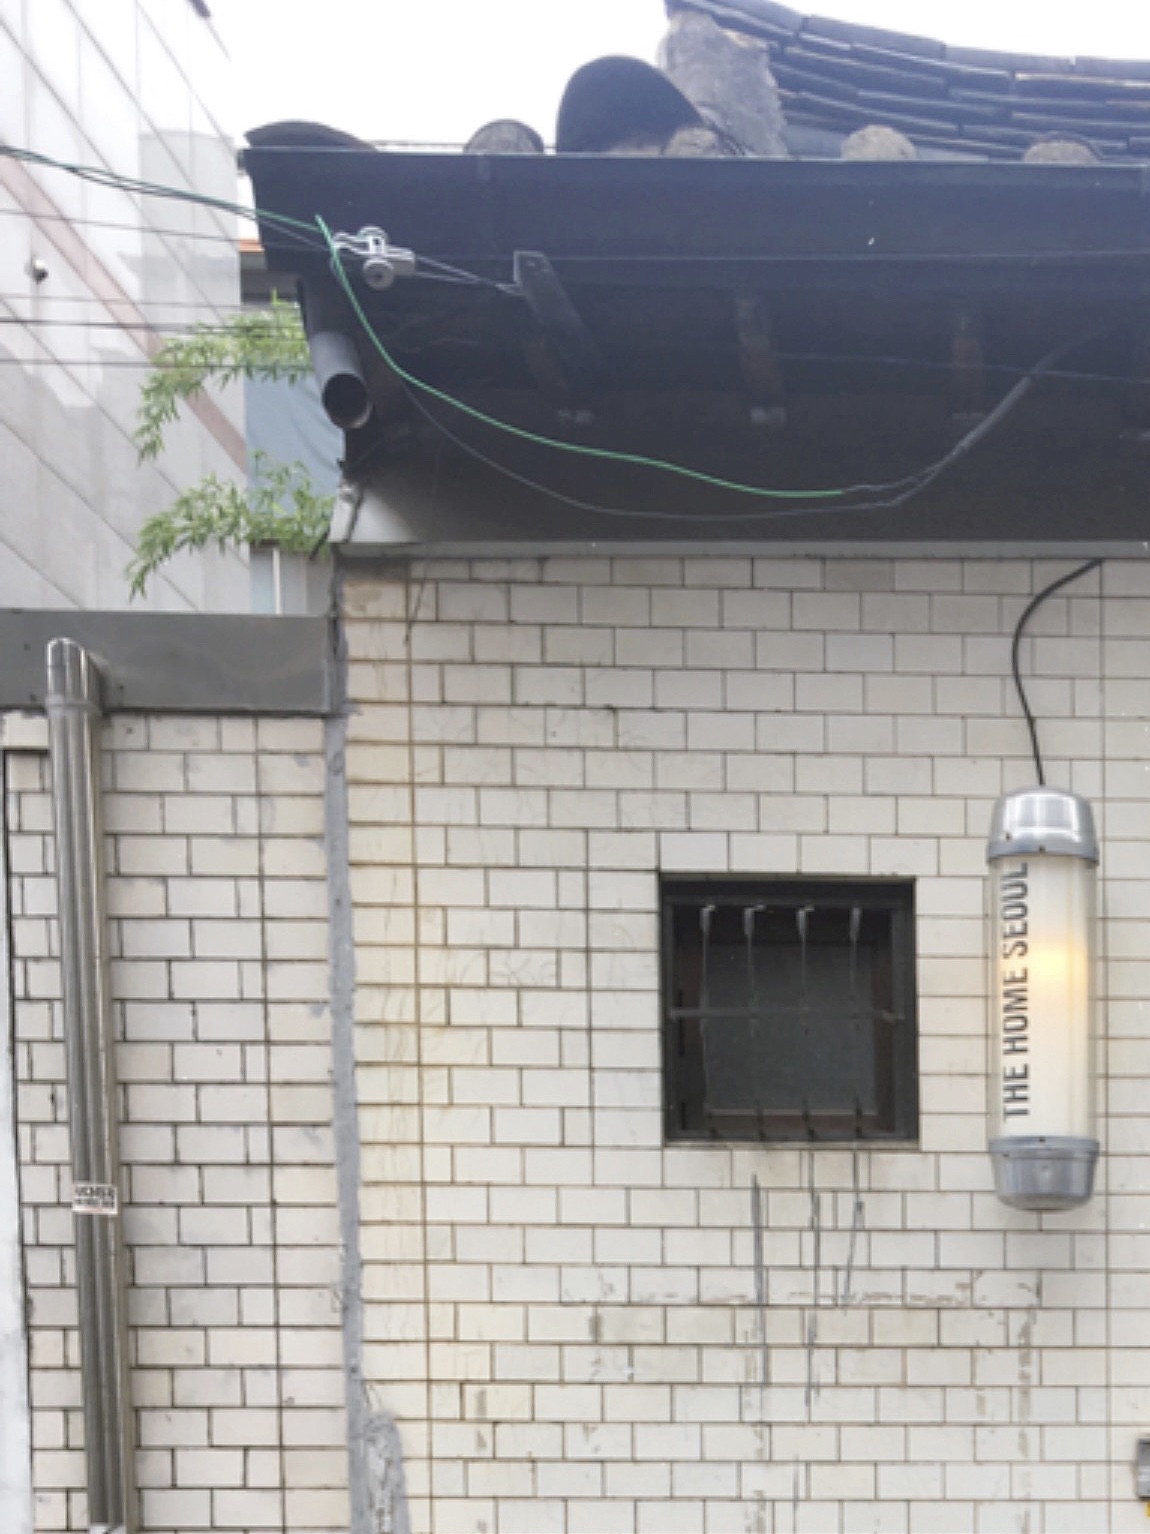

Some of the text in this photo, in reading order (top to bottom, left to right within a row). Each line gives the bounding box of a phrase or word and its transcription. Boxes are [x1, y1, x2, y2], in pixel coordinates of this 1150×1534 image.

[1001, 862, 1029, 1123] THE HOME SEOUL
